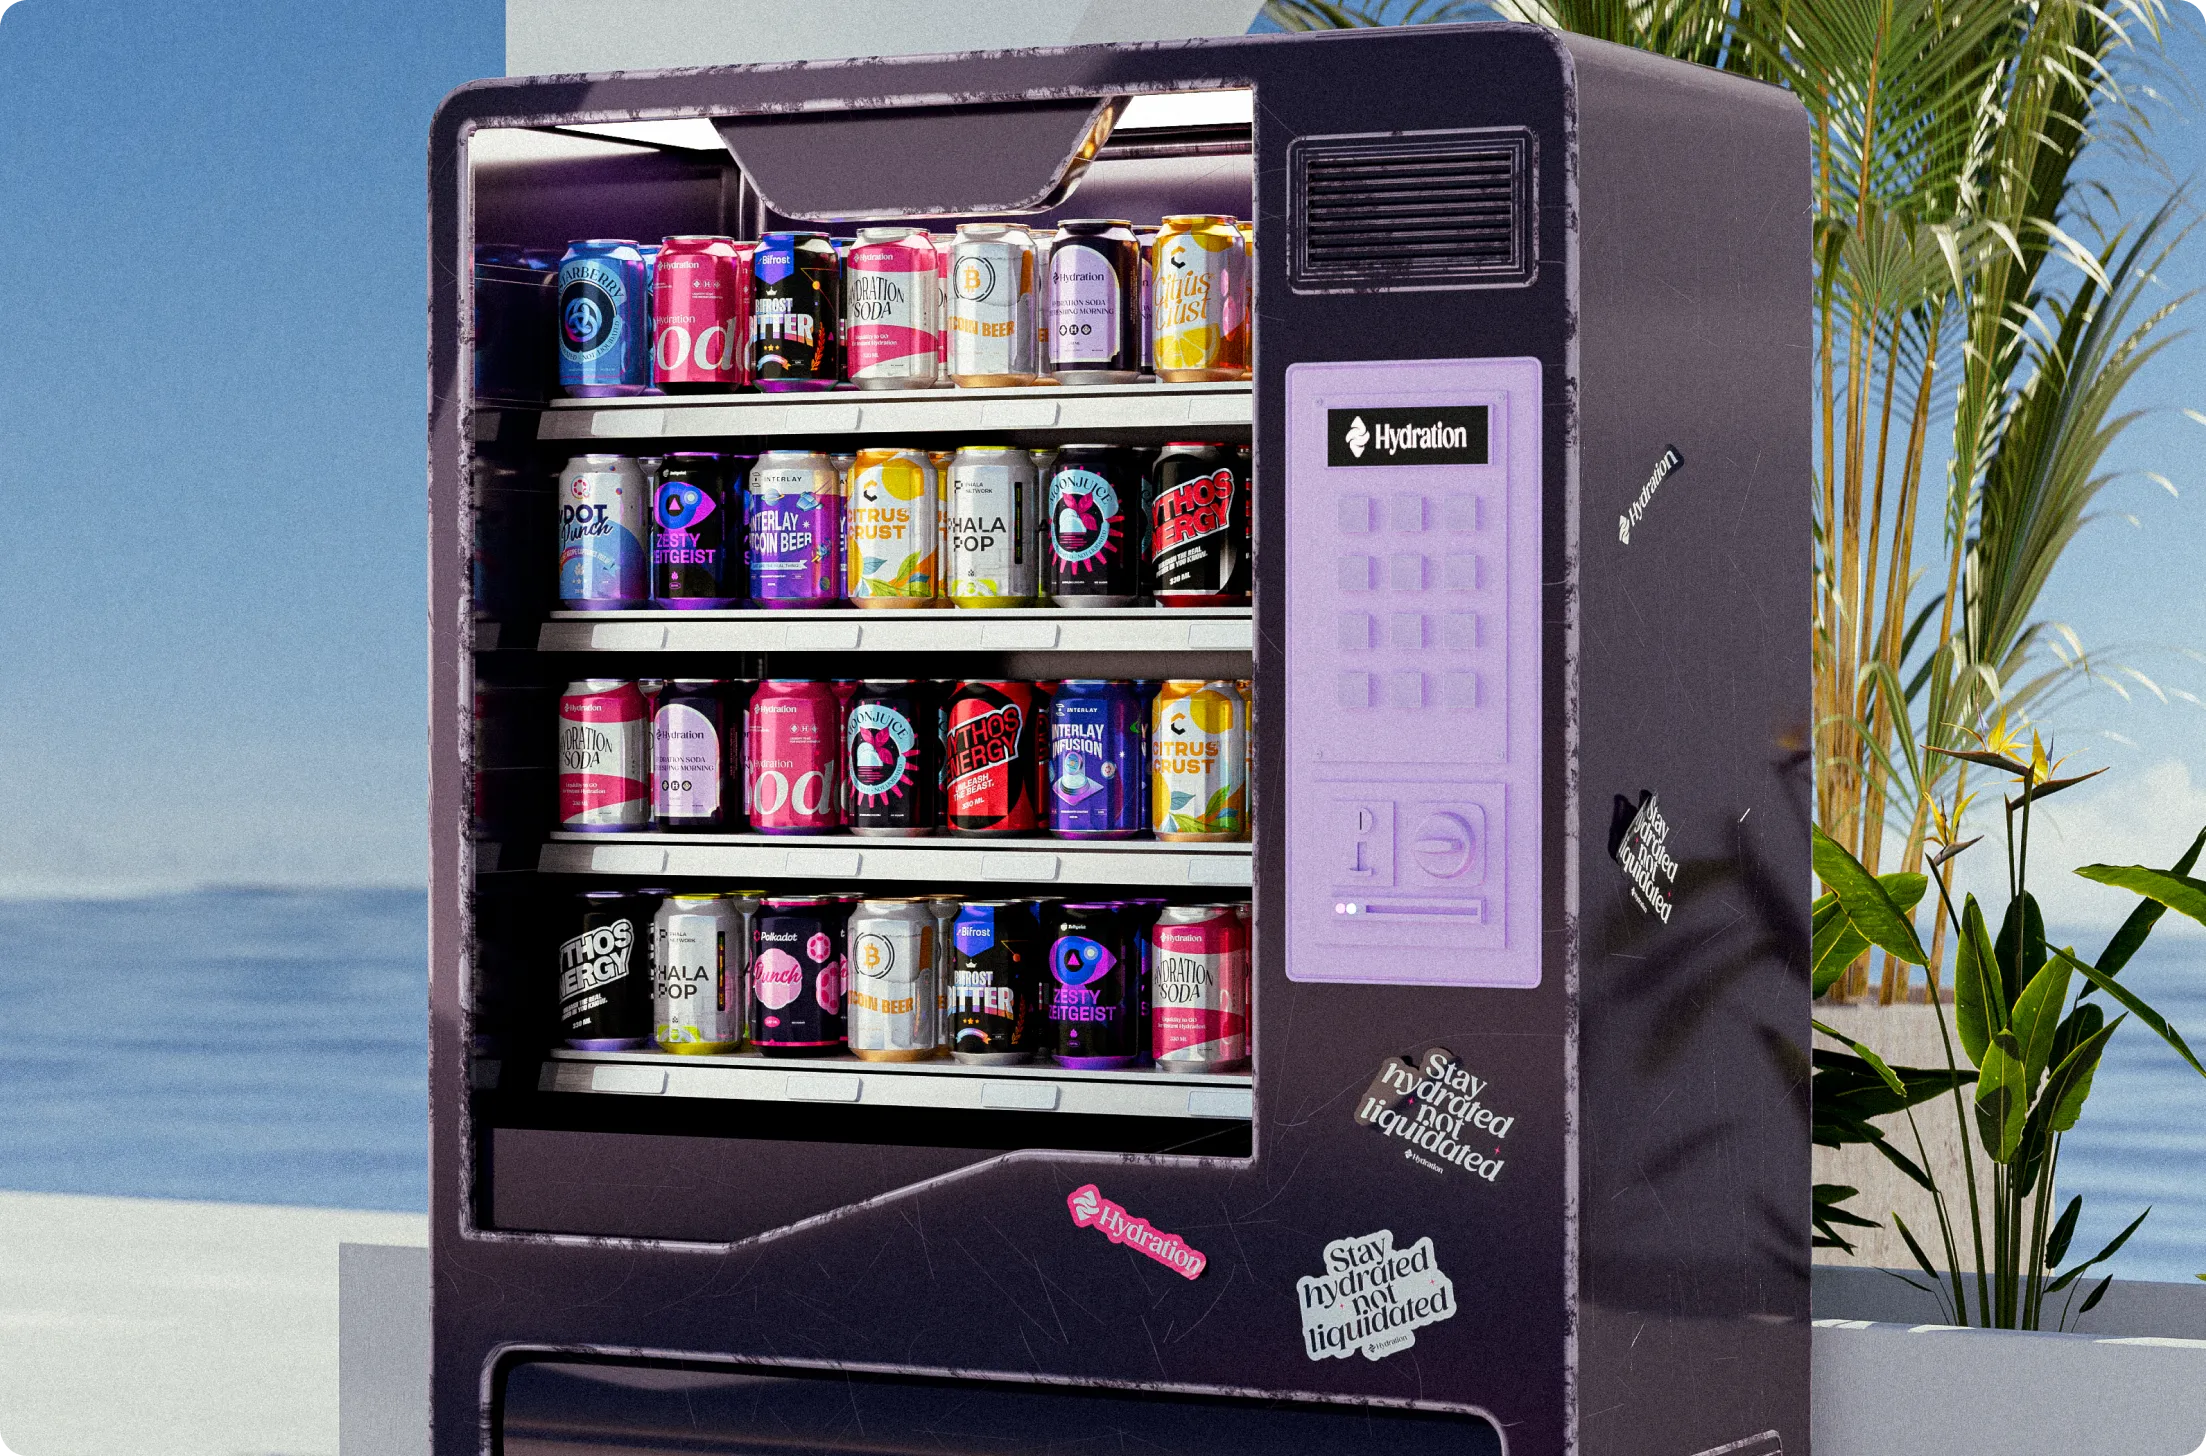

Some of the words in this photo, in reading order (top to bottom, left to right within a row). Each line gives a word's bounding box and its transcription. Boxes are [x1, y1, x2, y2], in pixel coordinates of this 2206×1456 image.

[664, 261, 699, 270] Hydration
[762, 254, 791, 264] Bifrost
[859, 254, 894, 263] Hydration
[1060, 272, 1105, 283] Hydration
[756, 298, 794, 313] BIFROST
[854, 301, 892, 321] SODA
[1079, 307, 1114, 315] MORNING
[657, 315, 696, 326] Hydration
[981, 320, 1015, 338] BEER
[1375, 421, 1467, 455] Hydration
[1629, 450, 1679, 527] Hydration
[1151, 470, 1234, 530] YTHOS
[847, 507, 910, 522] CITRUS
[656, 533, 701, 548] ZESTY
[847, 524, 907, 540] CRUST
[781, 532, 812, 552] BEER
[953, 535, 996, 552] POP
[654, 549, 716, 564] EITGEIST
[1169, 575, 1181, 586] 330
[570, 704, 602, 712] Hydration
[760, 705, 798, 714] Hydration
[662, 730, 704, 741] Hydration
[1053, 739, 1103, 761] INFUSION
[1153, 741, 1219, 757] CITRUS
[564, 751, 600, 769] SODA
[681, 763, 715, 772] MORNING
[1153, 758, 1215, 774] CRUST
[953, 786, 971, 801] THE
[969, 778, 995, 797] BEAST.
[956, 772, 990, 791] UNLEASH
[961, 801, 975, 810] 330
[974, 797, 986, 806] ML
[1646, 796, 1669, 844] Stay
[1638, 843, 1658, 881] not
[761, 932, 798, 942] Polkadot
[961, 927, 991, 937] Bifrost
[1167, 934, 1203, 943] Hydration
[753, 962, 803, 989] Punch
[954, 970, 994, 986] BIFROST
[658, 982, 698, 1000] POP
[1053, 989, 1101, 1005] ZESTY
[1159, 984, 1201, 1003] SODA
[881, 997, 914, 1014] BEER
[1426, 1054, 1487, 1100] Stay
[1382, 1063, 1514, 1138] hydrated
[1417, 1104, 1465, 1141] not
[1361, 1097, 1505, 1182] liquidated
[1412, 1157, 1444, 1174] Hydration
[1099, 1206, 1201, 1274] Hydration
[1330, 1238, 1386, 1272] Stay
[1304, 1246, 1429, 1309] hydrated
[1352, 1283, 1398, 1316] not
[1308, 1286, 1448, 1353] liquidated
[1376, 1335, 1409, 1350] Hydration
